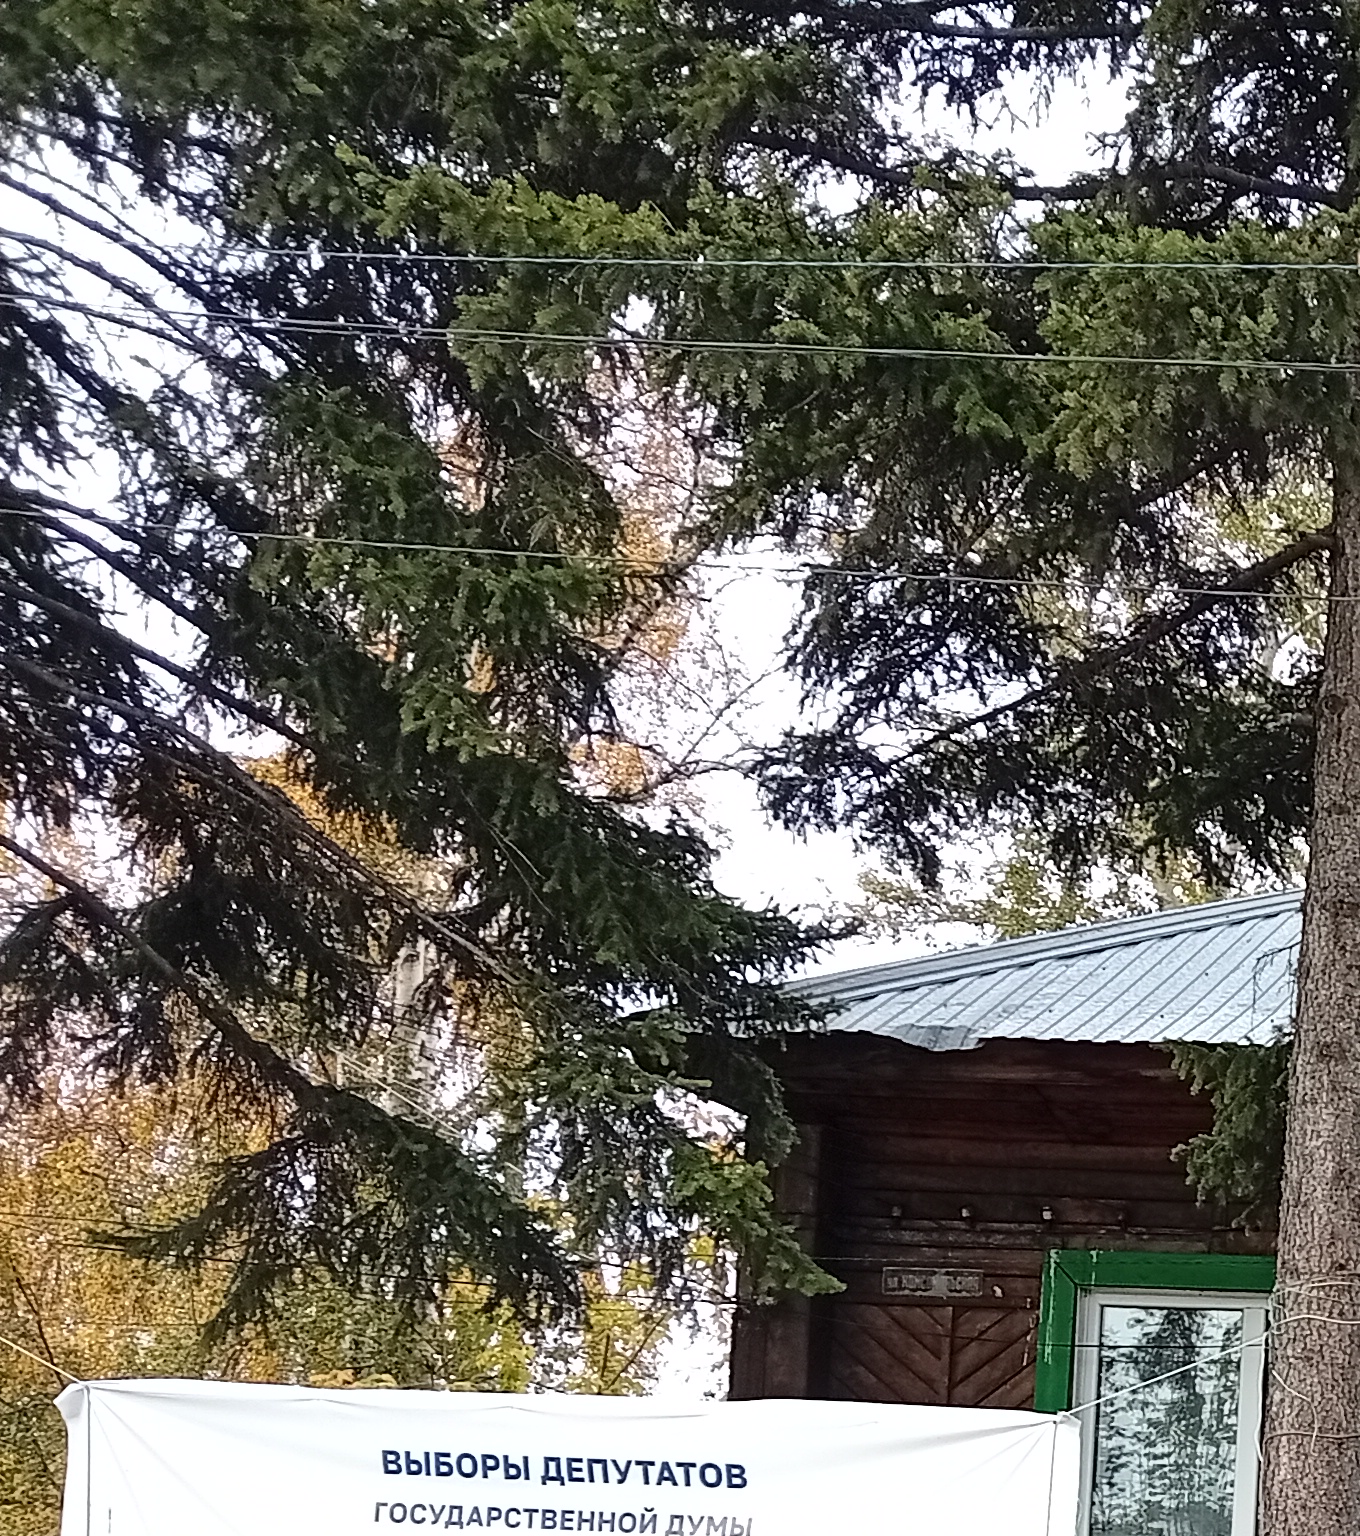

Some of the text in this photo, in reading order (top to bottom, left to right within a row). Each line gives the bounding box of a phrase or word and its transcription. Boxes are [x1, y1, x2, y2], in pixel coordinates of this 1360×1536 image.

[381, 1449, 748, 1490] ВЫБОРЫ ДЕПУТАТОВ
[373, 1501, 658, 1535] ГОСУДАРСТВЕННОЙ
